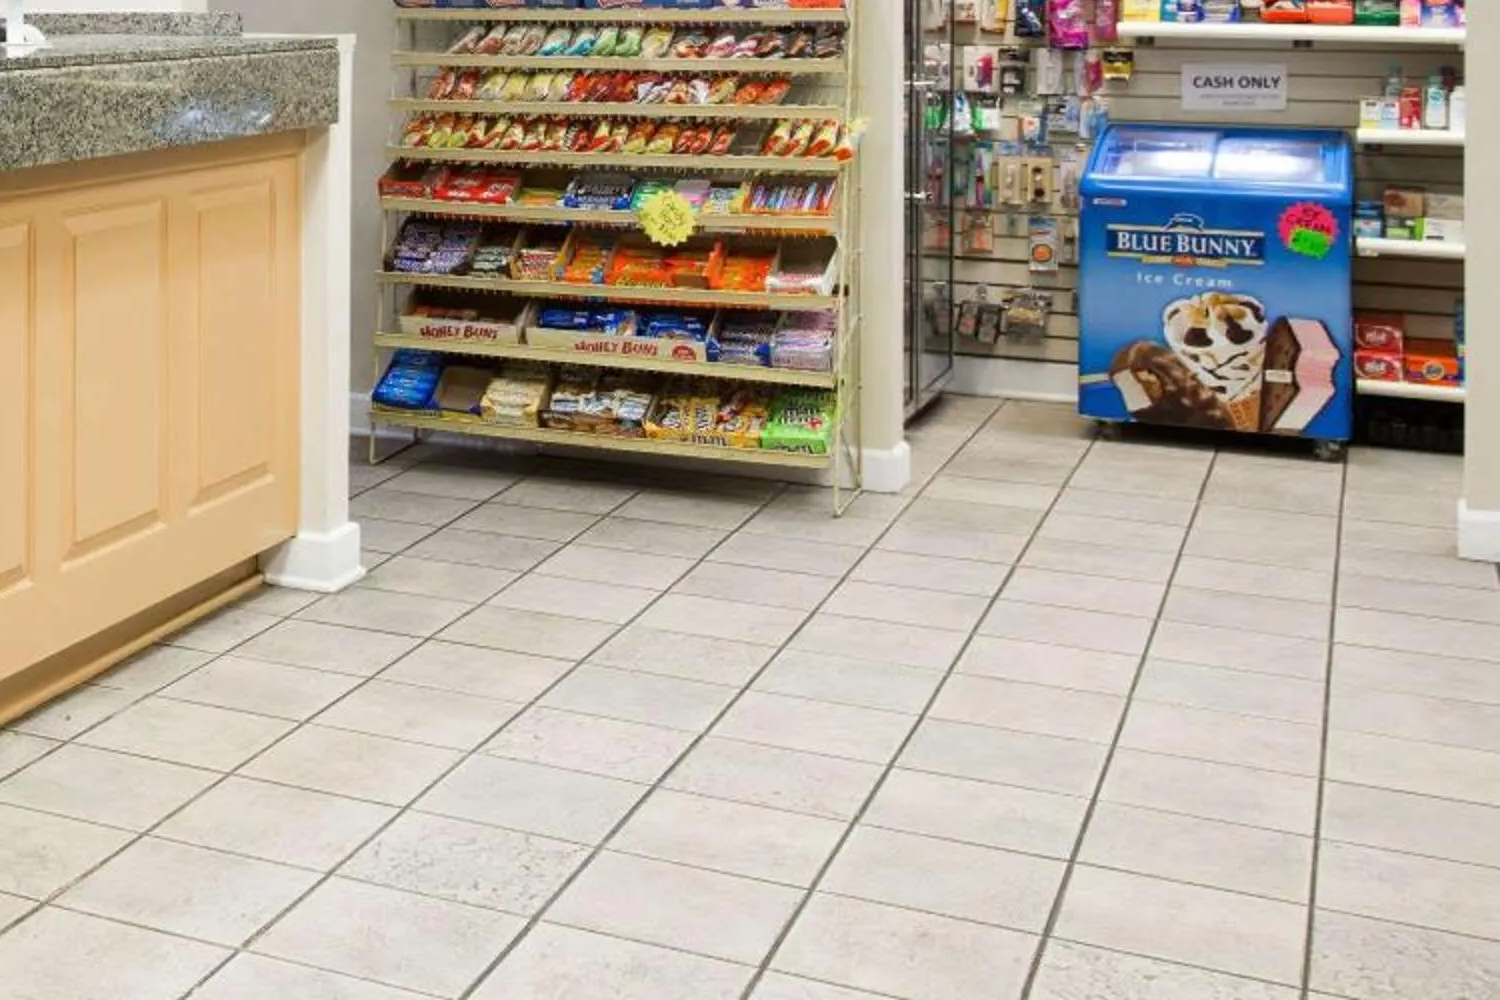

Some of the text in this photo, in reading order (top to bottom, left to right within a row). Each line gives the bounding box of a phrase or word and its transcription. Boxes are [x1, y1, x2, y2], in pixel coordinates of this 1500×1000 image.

[1192, 75, 1281, 89] CASH ONLY
[1116, 231, 1256, 257] BLUE BUNNY
[1136, 271, 1233, 288] Ice Cream
